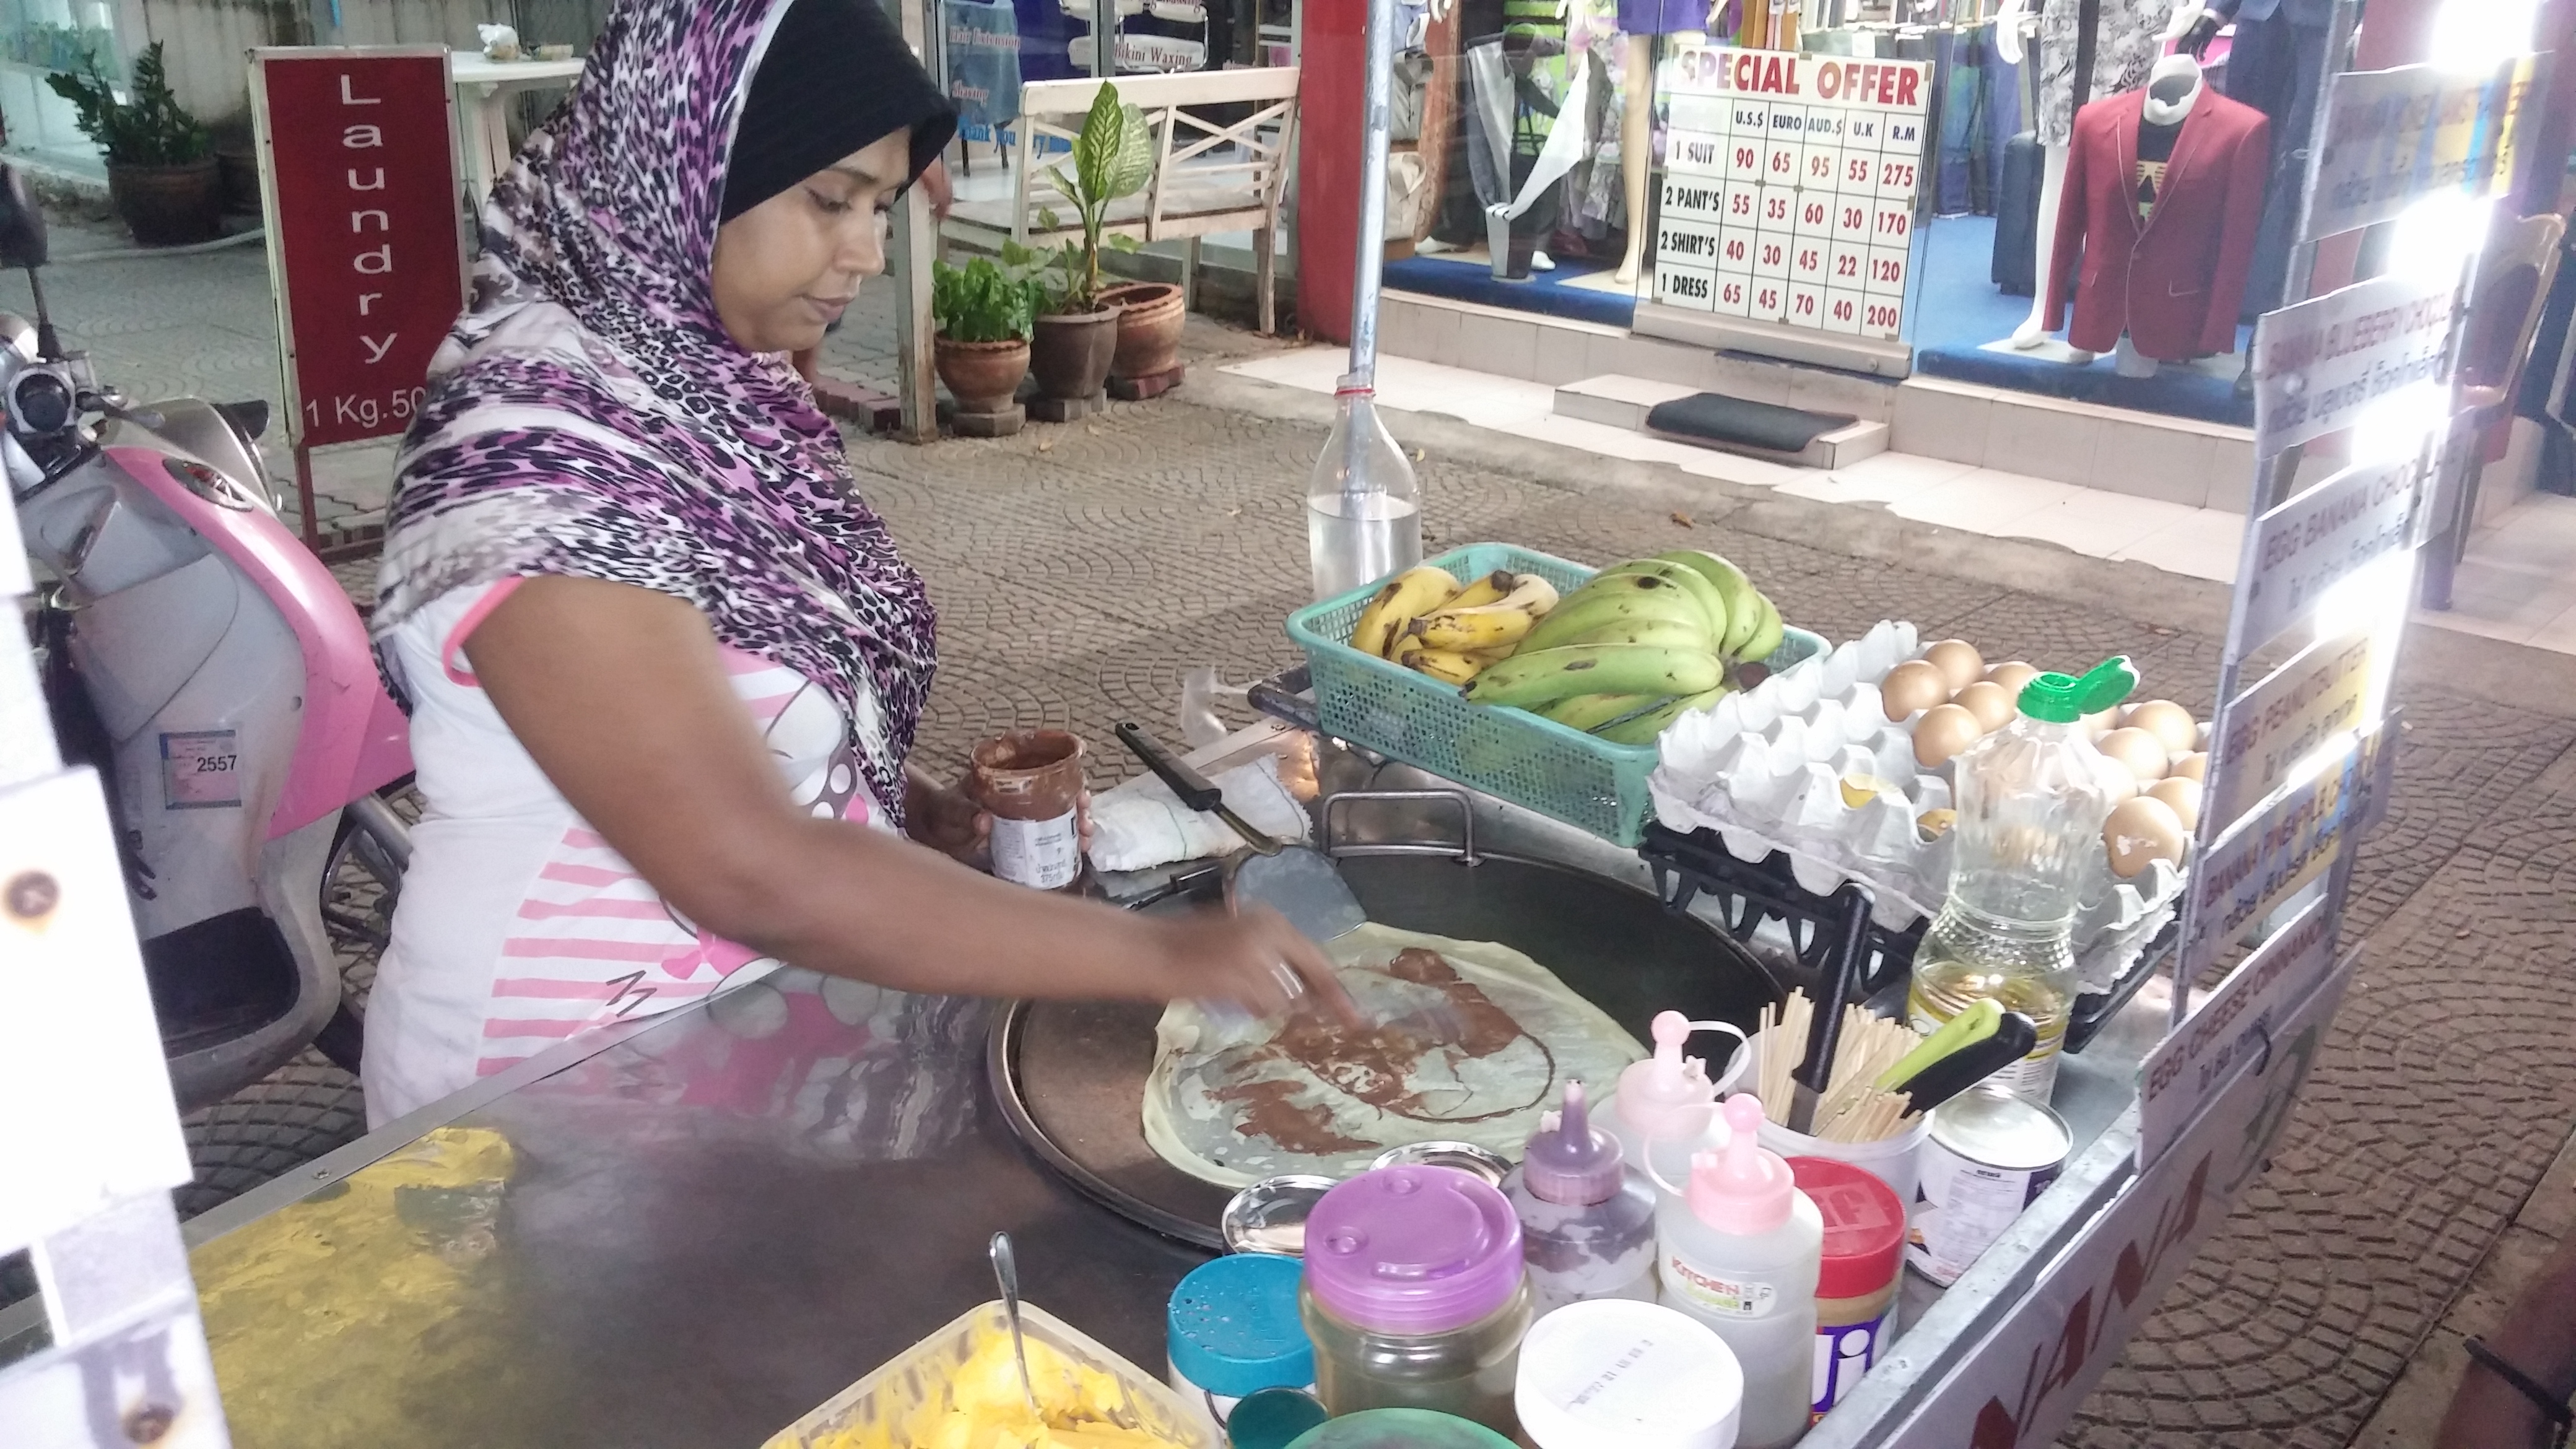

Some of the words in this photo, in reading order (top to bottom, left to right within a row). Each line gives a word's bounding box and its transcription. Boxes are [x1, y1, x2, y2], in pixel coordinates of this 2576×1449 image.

[1115, 43, 1144, 61] Bikini
[1151, 47, 1192, 66] Waxing
[1681, 50, 1800, 95] SPECIAL
[1817, 61, 1920, 106] OFFER
[1736, 110, 1764, 129] U.S.$
[1773, 114, 1802, 131] EURO
[1808, 118, 1842, 135] AUD.$
[1854, 121, 1874, 137] U.K
[1893, 126, 1915, 141] R.M
[1675, 141, 1681, 161] 1
[1687, 141, 1715, 164] SUIT
[1736, 148, 1754, 169] 90
[1773, 152, 1791, 173] 65
[1811, 156, 1830, 177] 95
[1849, 160, 1868, 181] 55
[1884, 163, 1914, 188] 275
[339, 74, 398, 364] Laundry
[1666, 186, 1673, 206] 2
[1677, 188, 1720, 211] PANT'S
[1733, 194, 1750, 215] 55
[1767, 198, 1785, 219] 35
[1805, 203, 1824, 225] 60
[1843, 207, 1863, 230] 30
[1878, 213, 1906, 235] 170
[1661, 231, 1668, 250] 2
[1671, 232, 1715, 256] SHIRT'S
[1726, 240, 1744, 261] 40
[1763, 245, 1781, 266] 30
[1799, 251, 1818, 271] 45
[1837, 255, 1856, 277] 22
[1873, 259, 1900, 282] 120
[1662, 273, 1666, 292] 1
[1673, 274, 1708, 298] DRESS
[1723, 283, 1741, 303] 65
[1759, 289, 1777, 310] 45
[1796, 294, 1814, 315] 70
[1834, 300, 1852, 321] 40
[1866, 305, 1897, 328] 200
[306, 399, 319, 427] 1
[197, 755, 237, 772] 2557
[1672, 1256, 1740, 1295] KITCHEN
